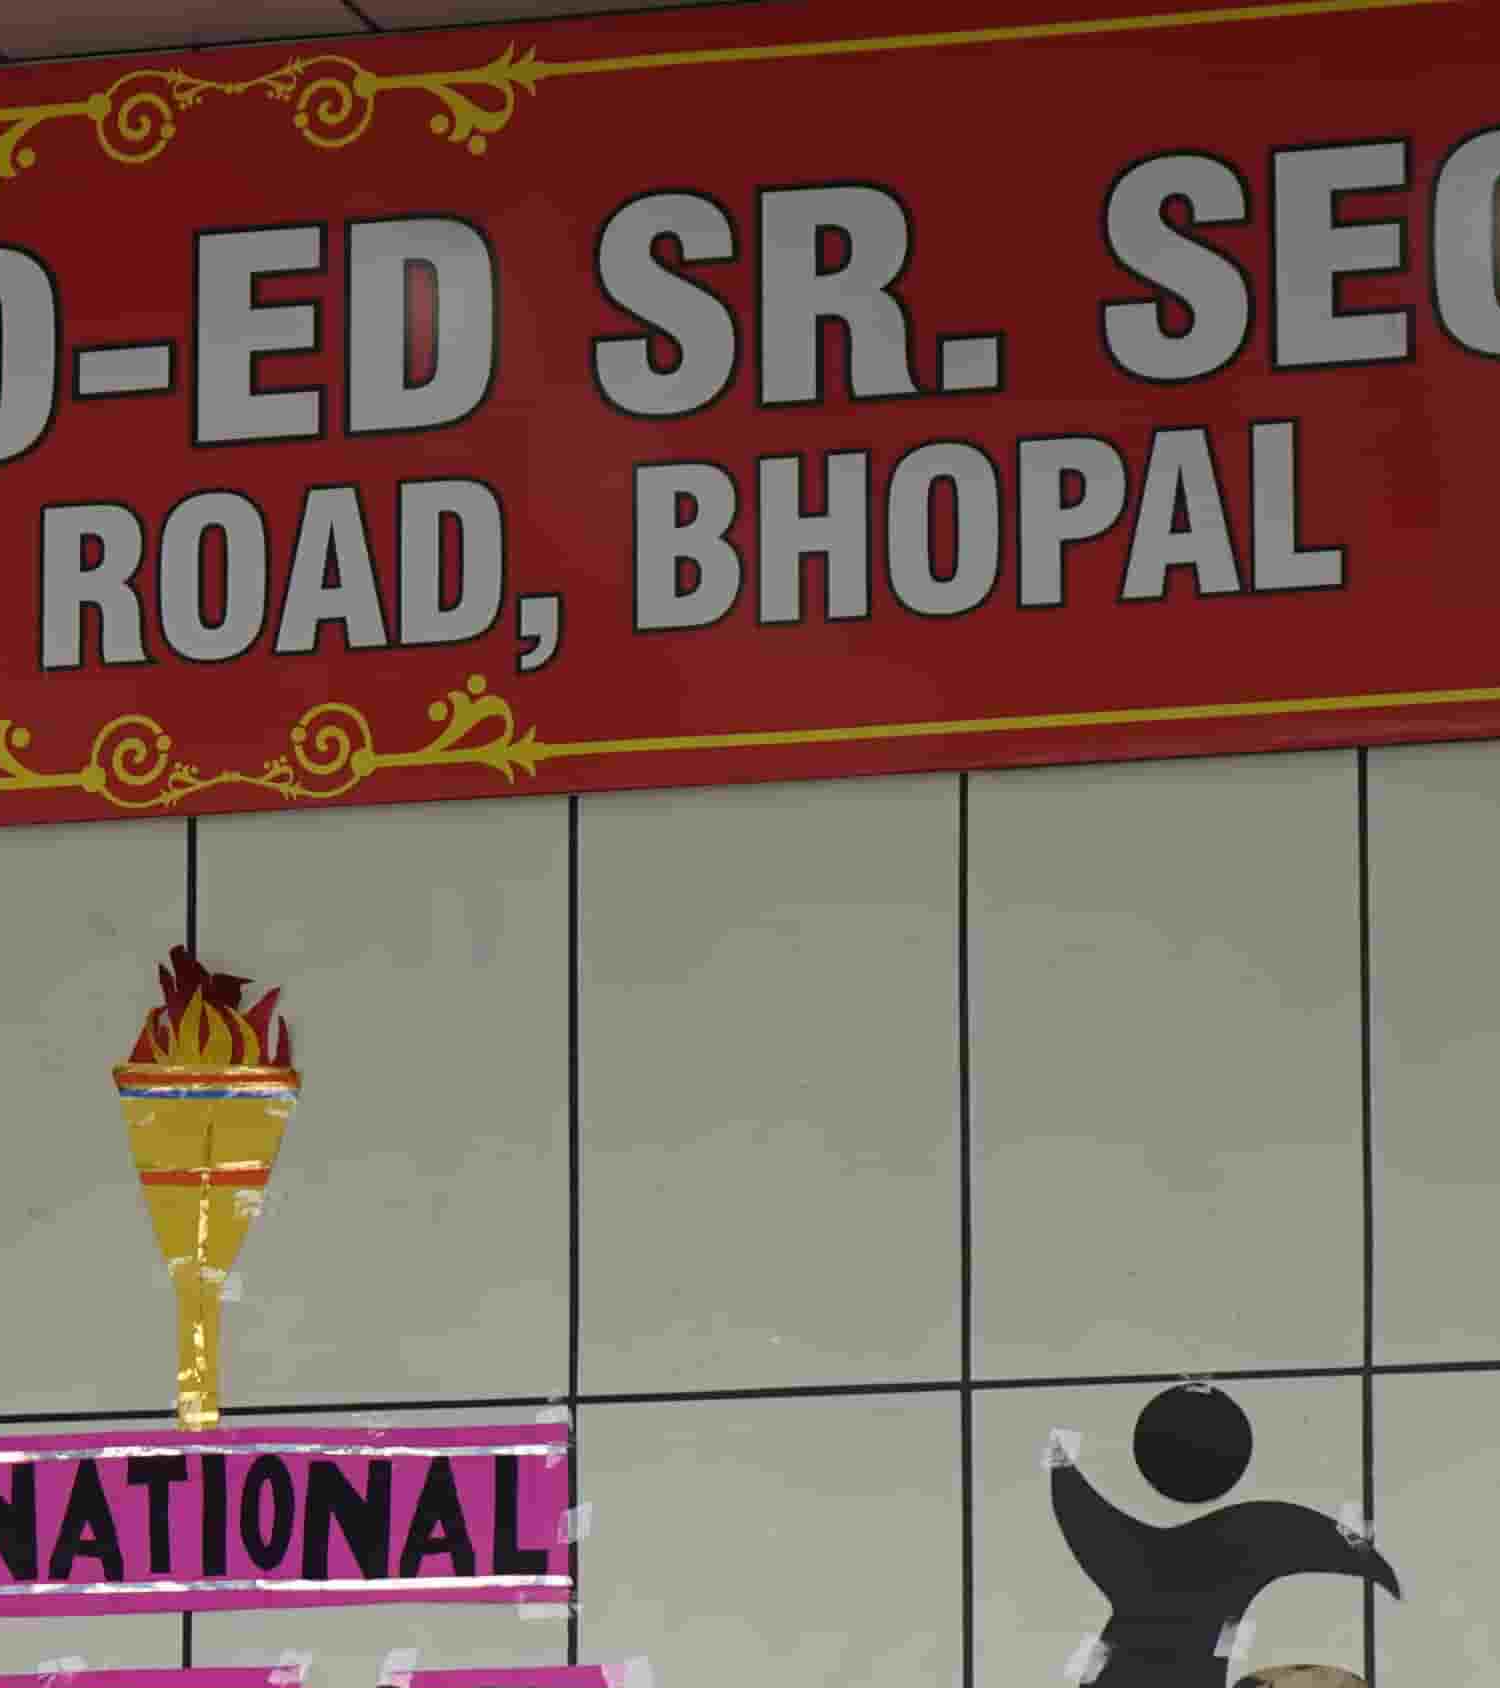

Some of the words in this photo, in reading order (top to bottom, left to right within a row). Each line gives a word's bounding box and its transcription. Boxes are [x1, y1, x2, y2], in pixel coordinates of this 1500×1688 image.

[590, 181, 1003, 421] SR.
[38, 475, 563, 675] ROAD,
[632, 417, 1347, 634] BHOPAL
